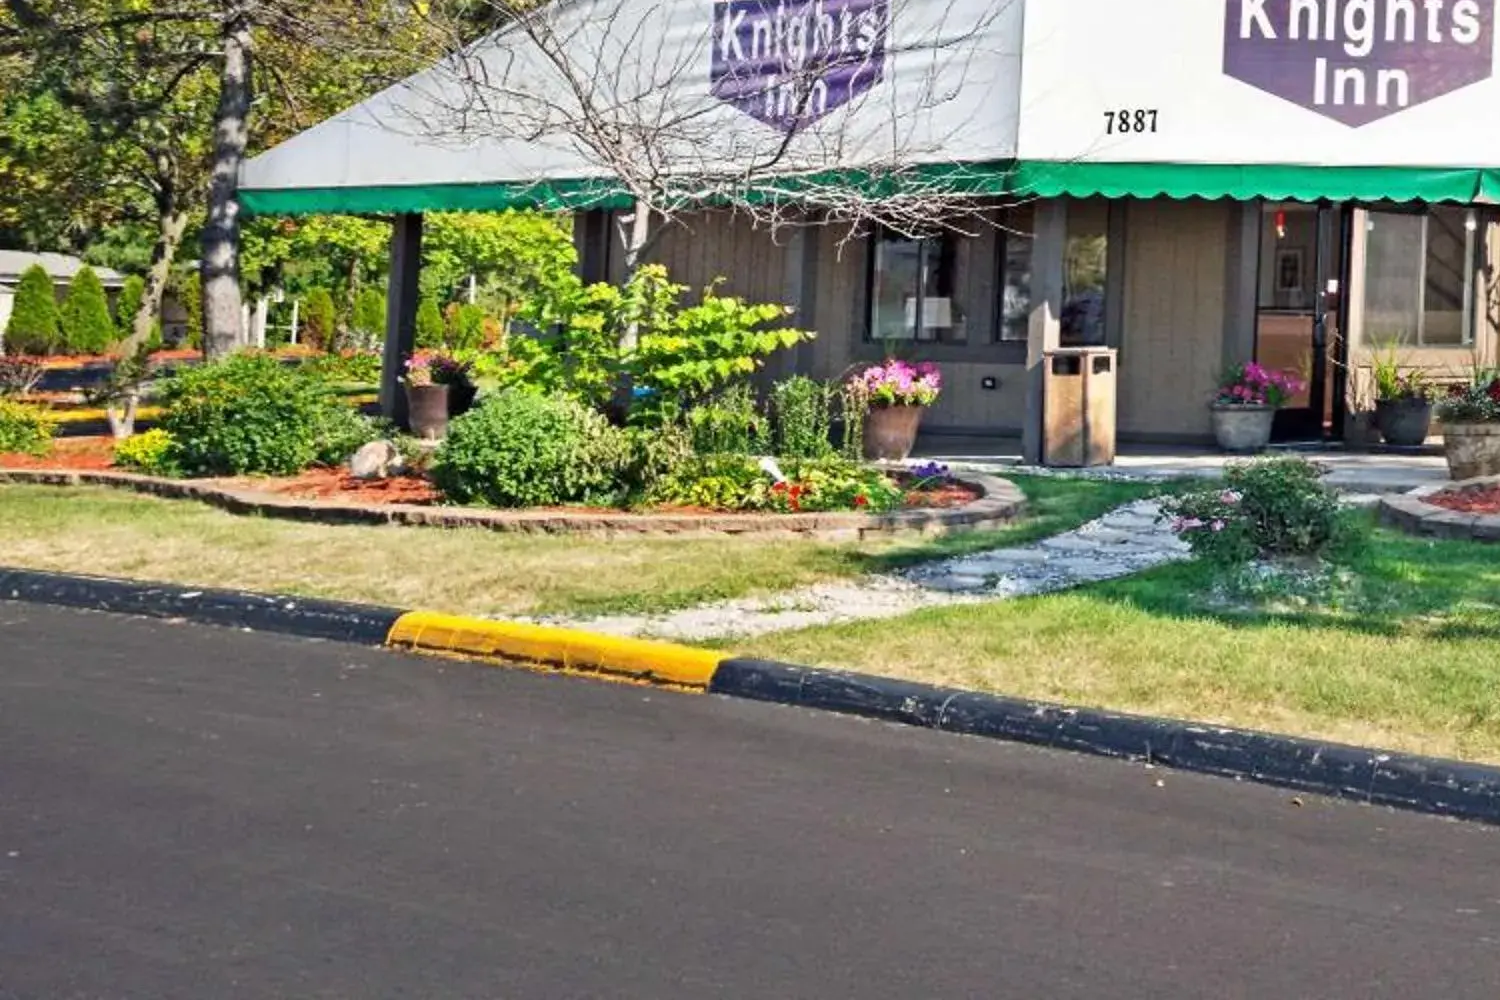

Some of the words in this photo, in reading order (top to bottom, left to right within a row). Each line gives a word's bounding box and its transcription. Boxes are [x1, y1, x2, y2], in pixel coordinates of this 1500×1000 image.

[720, 2, 877, 68] Knights
[765, 73, 829, 119] Inn
[1313, 57, 1410, 107] Inn
[1103, 109, 1158, 135] 7887
